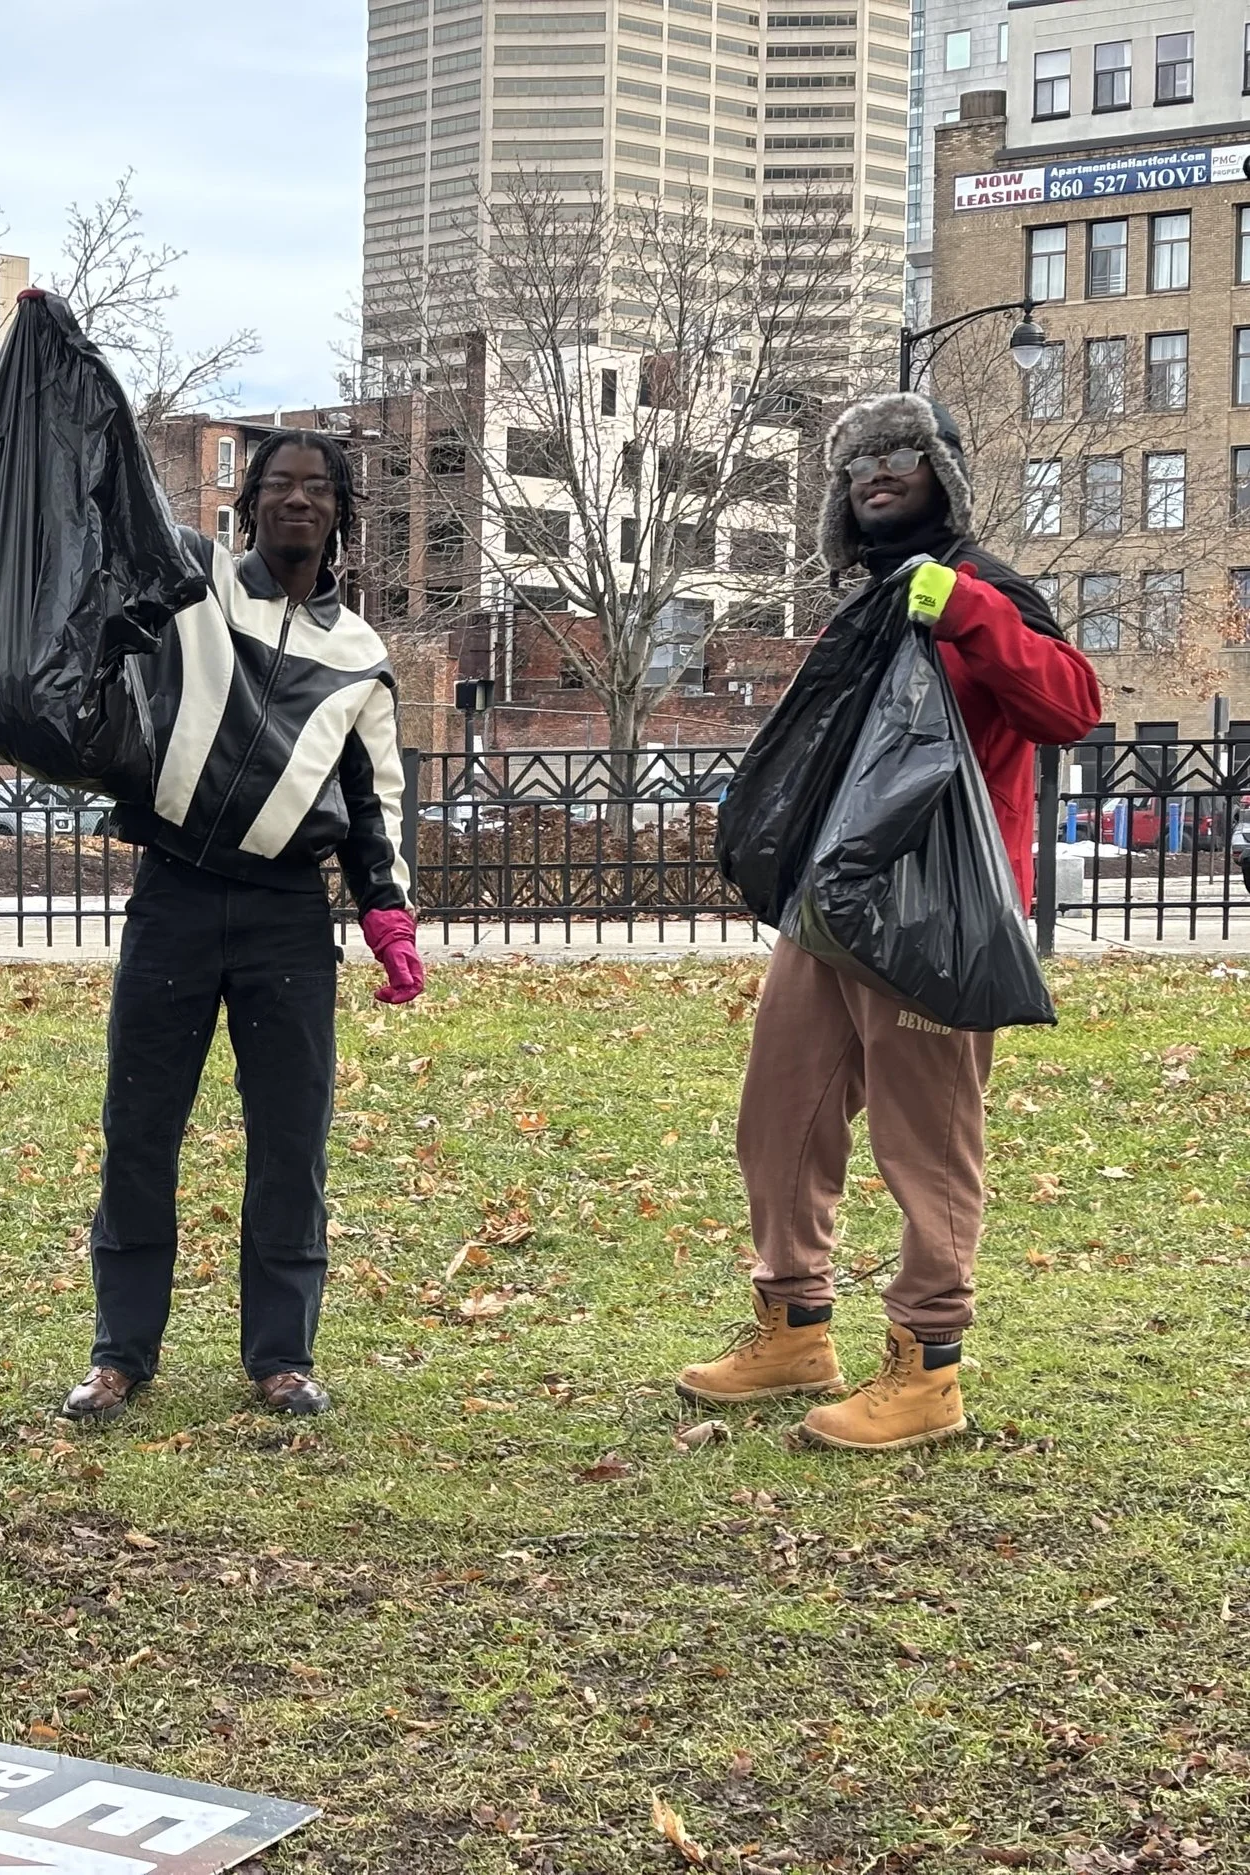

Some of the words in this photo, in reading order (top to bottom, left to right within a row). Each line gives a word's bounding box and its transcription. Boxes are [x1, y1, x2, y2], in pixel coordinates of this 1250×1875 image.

[1051, 153, 1206, 178] ApartmentsinHartford.Com
[1212, 154, 1237, 166] PMC
[975, 173, 1024, 189] NOW
[1050, 178, 1083, 199] 860
[1093, 173, 1128, 194] 527
[1136, 165, 1207, 189] MOVE
[1213, 168, 1244, 177] PROPER
[957, 187, 1042, 207] LEASING
[896, 1010, 952, 1035] BEYOND
